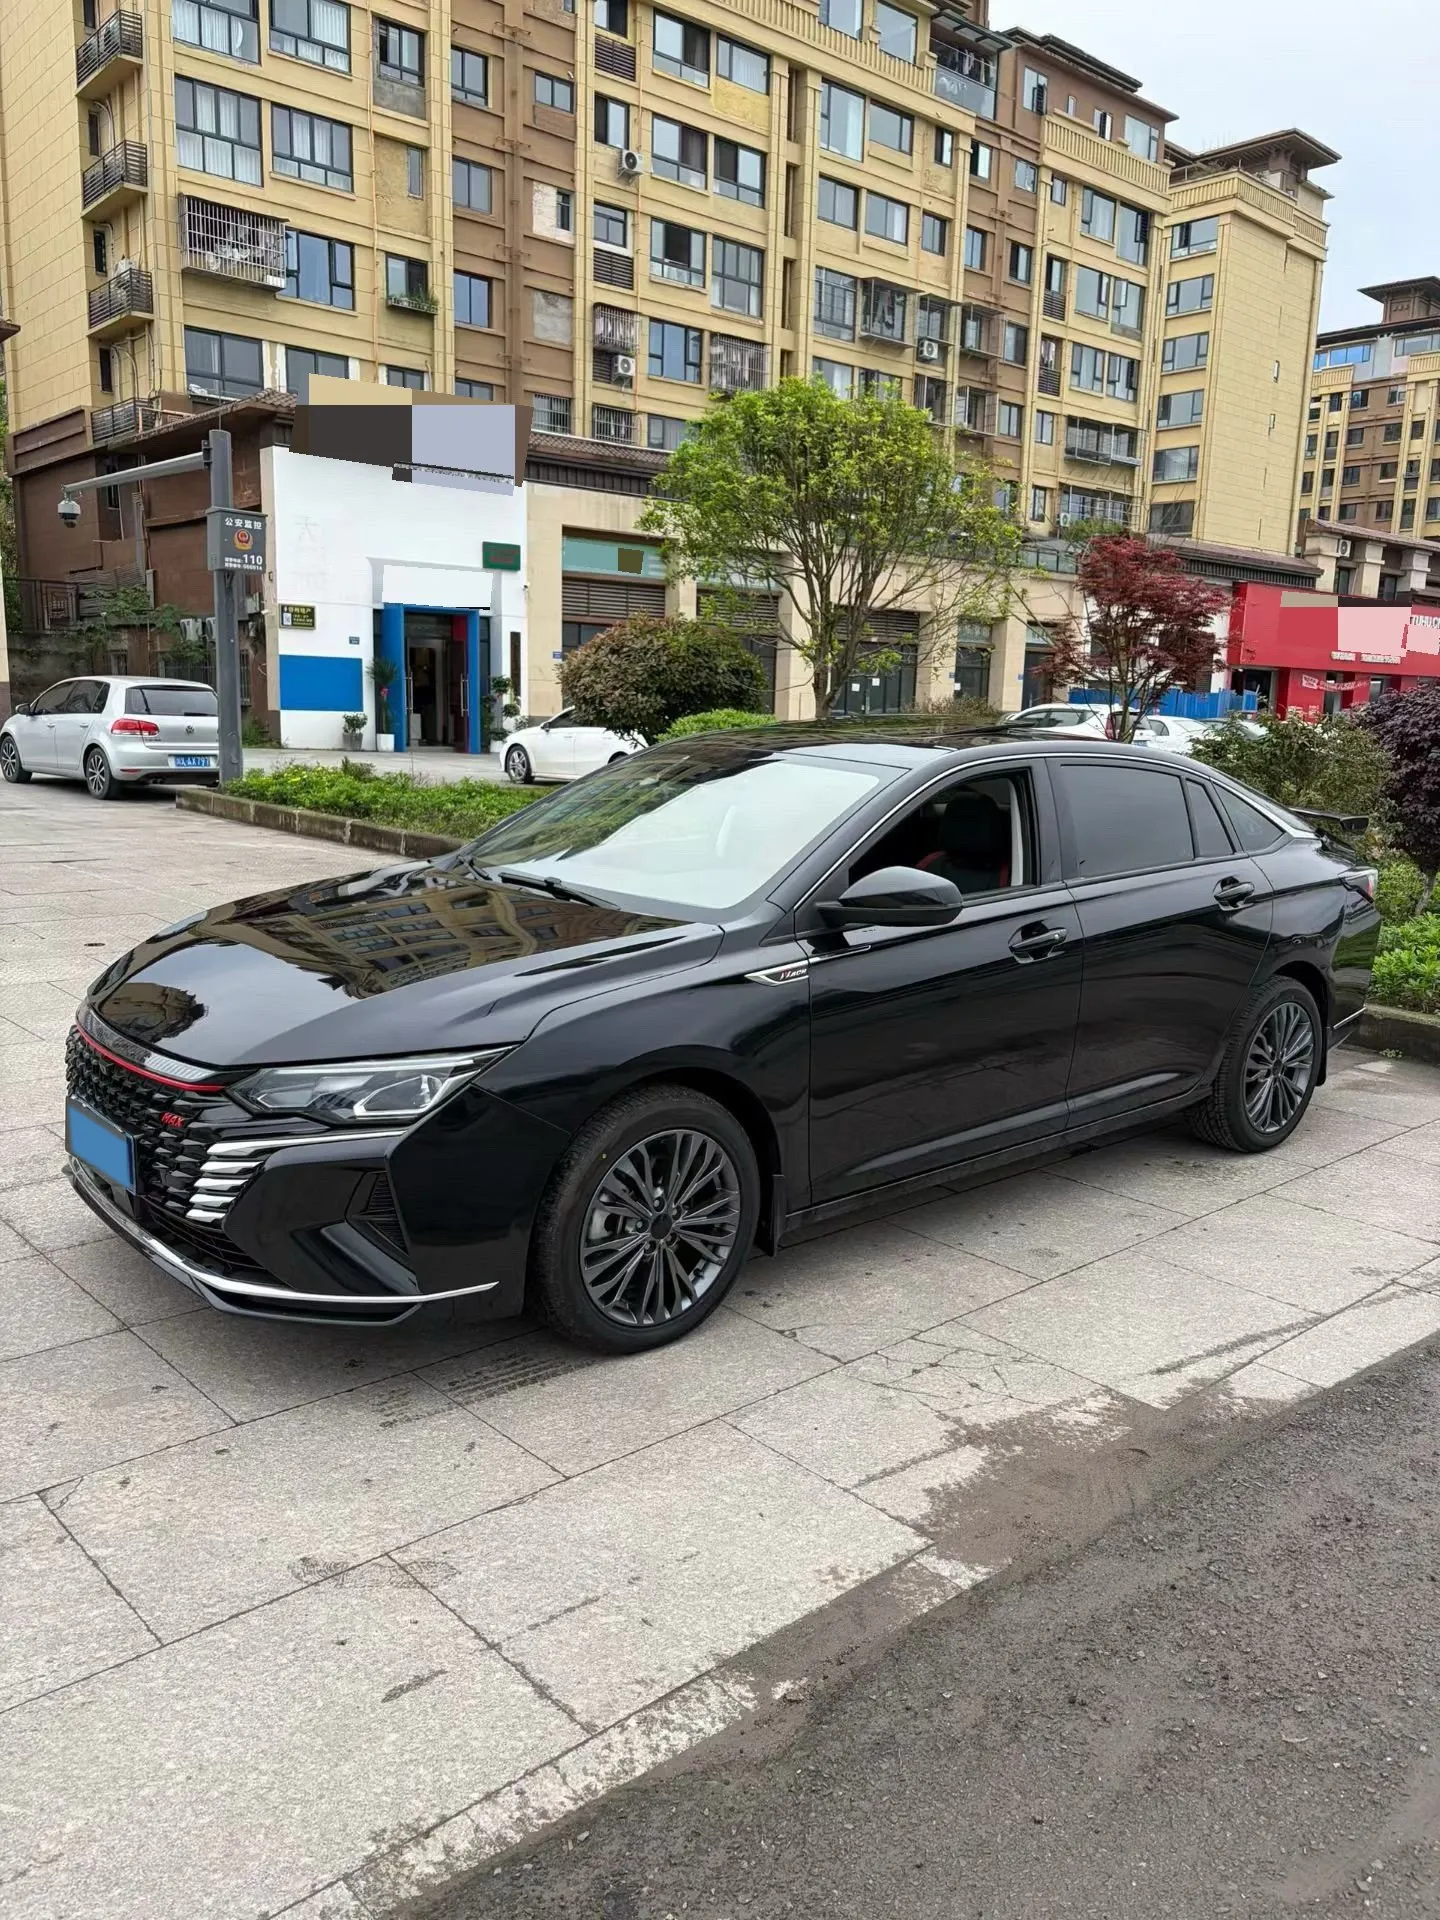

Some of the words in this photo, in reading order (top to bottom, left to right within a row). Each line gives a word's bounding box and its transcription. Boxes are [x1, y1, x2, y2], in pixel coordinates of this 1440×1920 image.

[225, 517, 262, 529] 公安监控
[243, 554, 263, 565] 110
[161, 1112, 184, 1128] MAX
